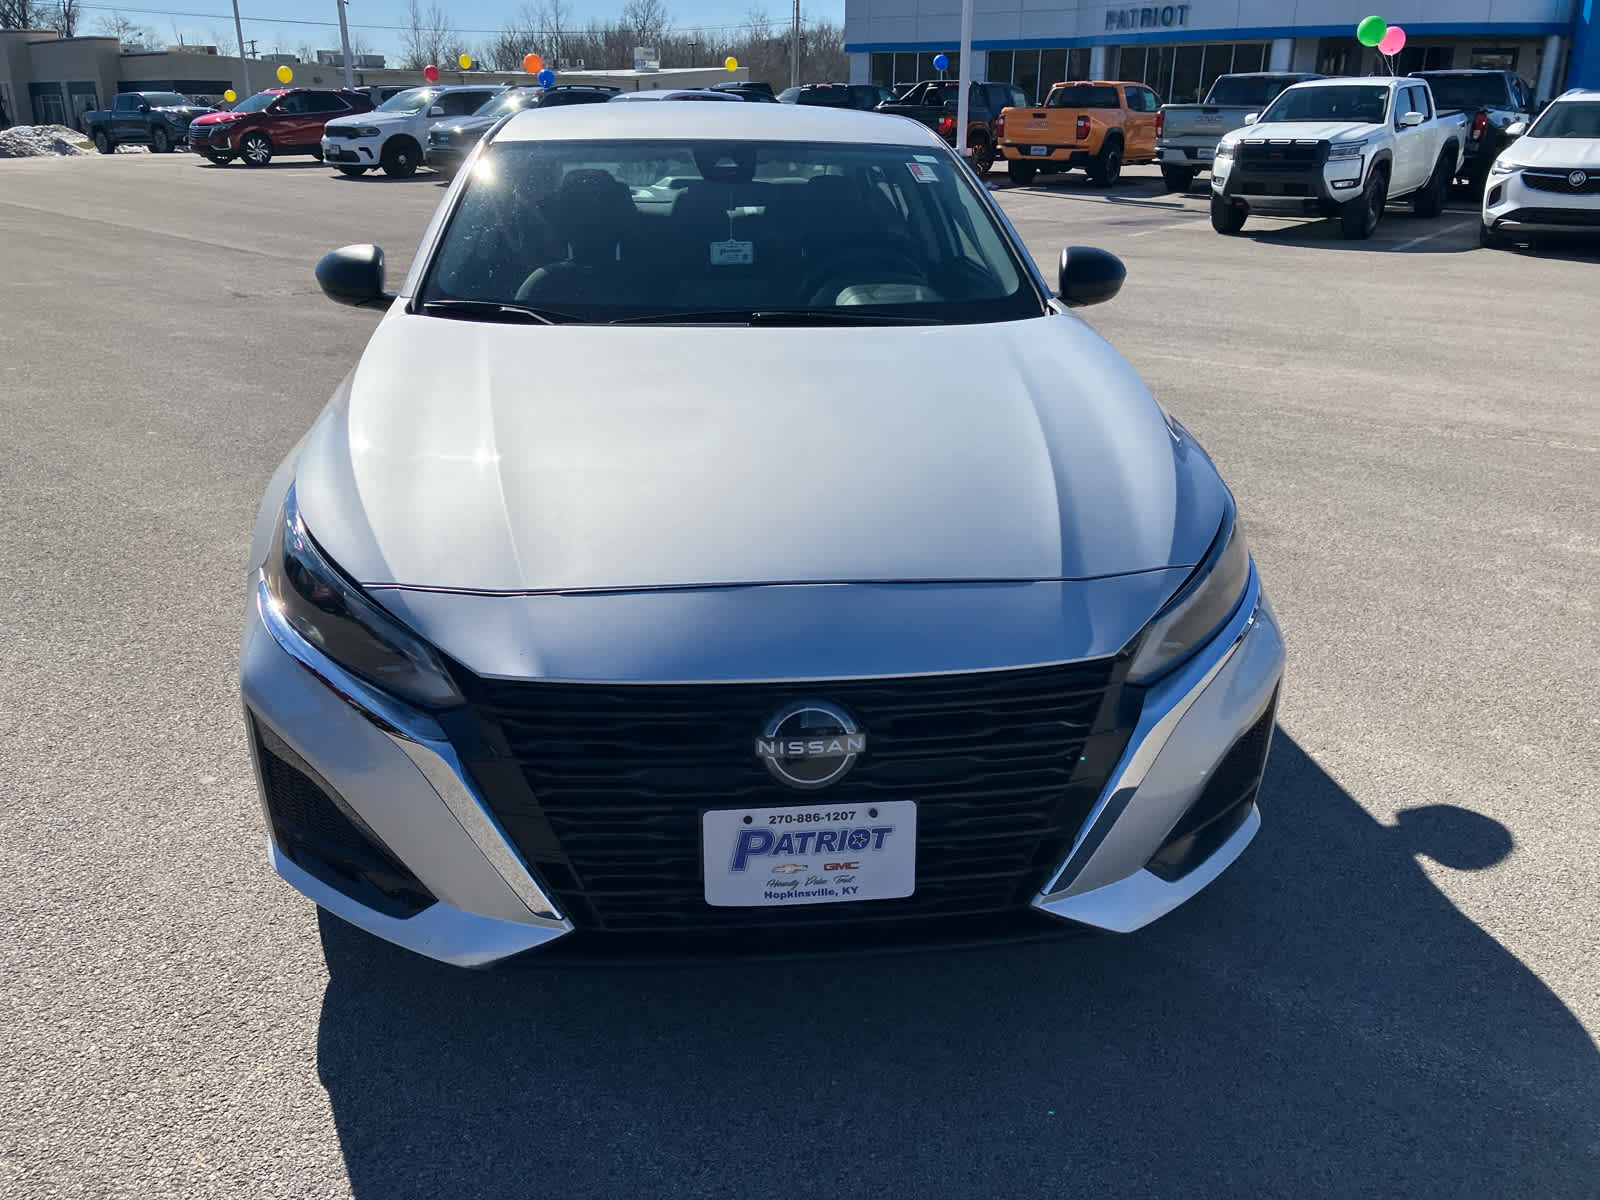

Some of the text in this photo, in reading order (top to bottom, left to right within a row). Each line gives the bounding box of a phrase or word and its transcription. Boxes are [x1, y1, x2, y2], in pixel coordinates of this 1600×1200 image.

[1104, 5, 1187, 31] PATRIOT
[758, 736, 863, 755] NISSAN
[768, 811, 856, 825] 270-886-1207
[731, 826, 893, 872] PATRIOT
[824, 861, 860, 871] GMC
[764, 886, 858, 900] Hopkinsville, KY
